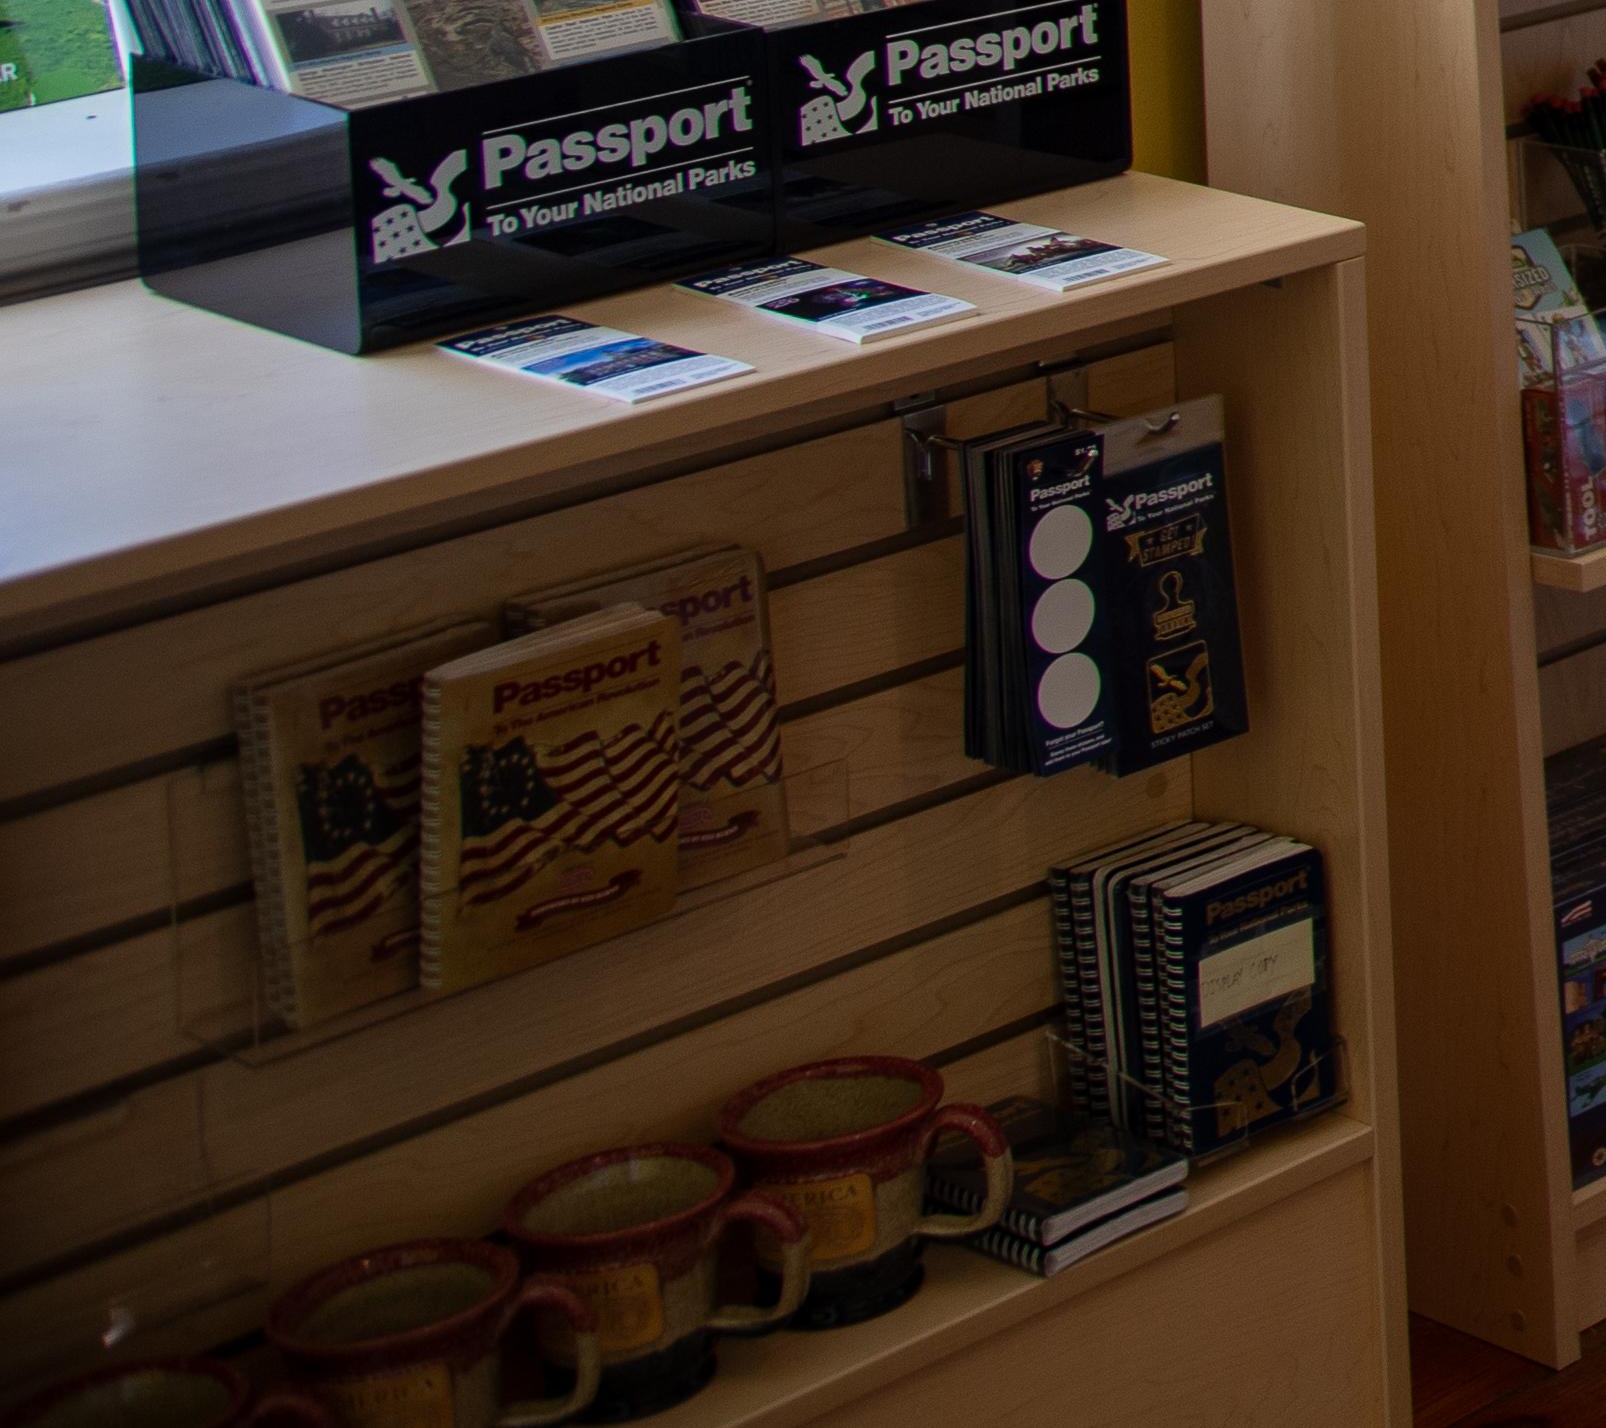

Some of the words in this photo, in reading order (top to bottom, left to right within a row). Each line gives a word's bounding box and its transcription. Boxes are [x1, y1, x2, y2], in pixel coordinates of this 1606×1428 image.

[886, 4, 1099, 86] Passport
[887, 106, 913, 127] To
[914, 94, 963, 125] Your
[963, 77, 1039, 112] National
[1040, 63, 1102, 95] Parks
[482, 79, 752, 190] Passport
[486, 212, 519, 238] To
[518, 199, 580, 232] Your
[581, 175, 685, 214] National
[686, 156, 758, 193] Parks
[1029, 474, 1092, 504] Passport
[1134, 471, 1214, 510] Passport
[1160, 527, 1180, 543] GET
[492, 641, 661, 714] Passport
[492, 721, 508, 736] To
[509, 710, 534, 732] The
[534, 698, 597, 723] American
[597, 677, 661, 703] Revolution
[1150, 733, 1177, 750] STICKY
[1176, 727, 1199, 743] PATCH
[1198, 720, 1215, 734] SET
[1204, 871, 1309, 926] Passport
